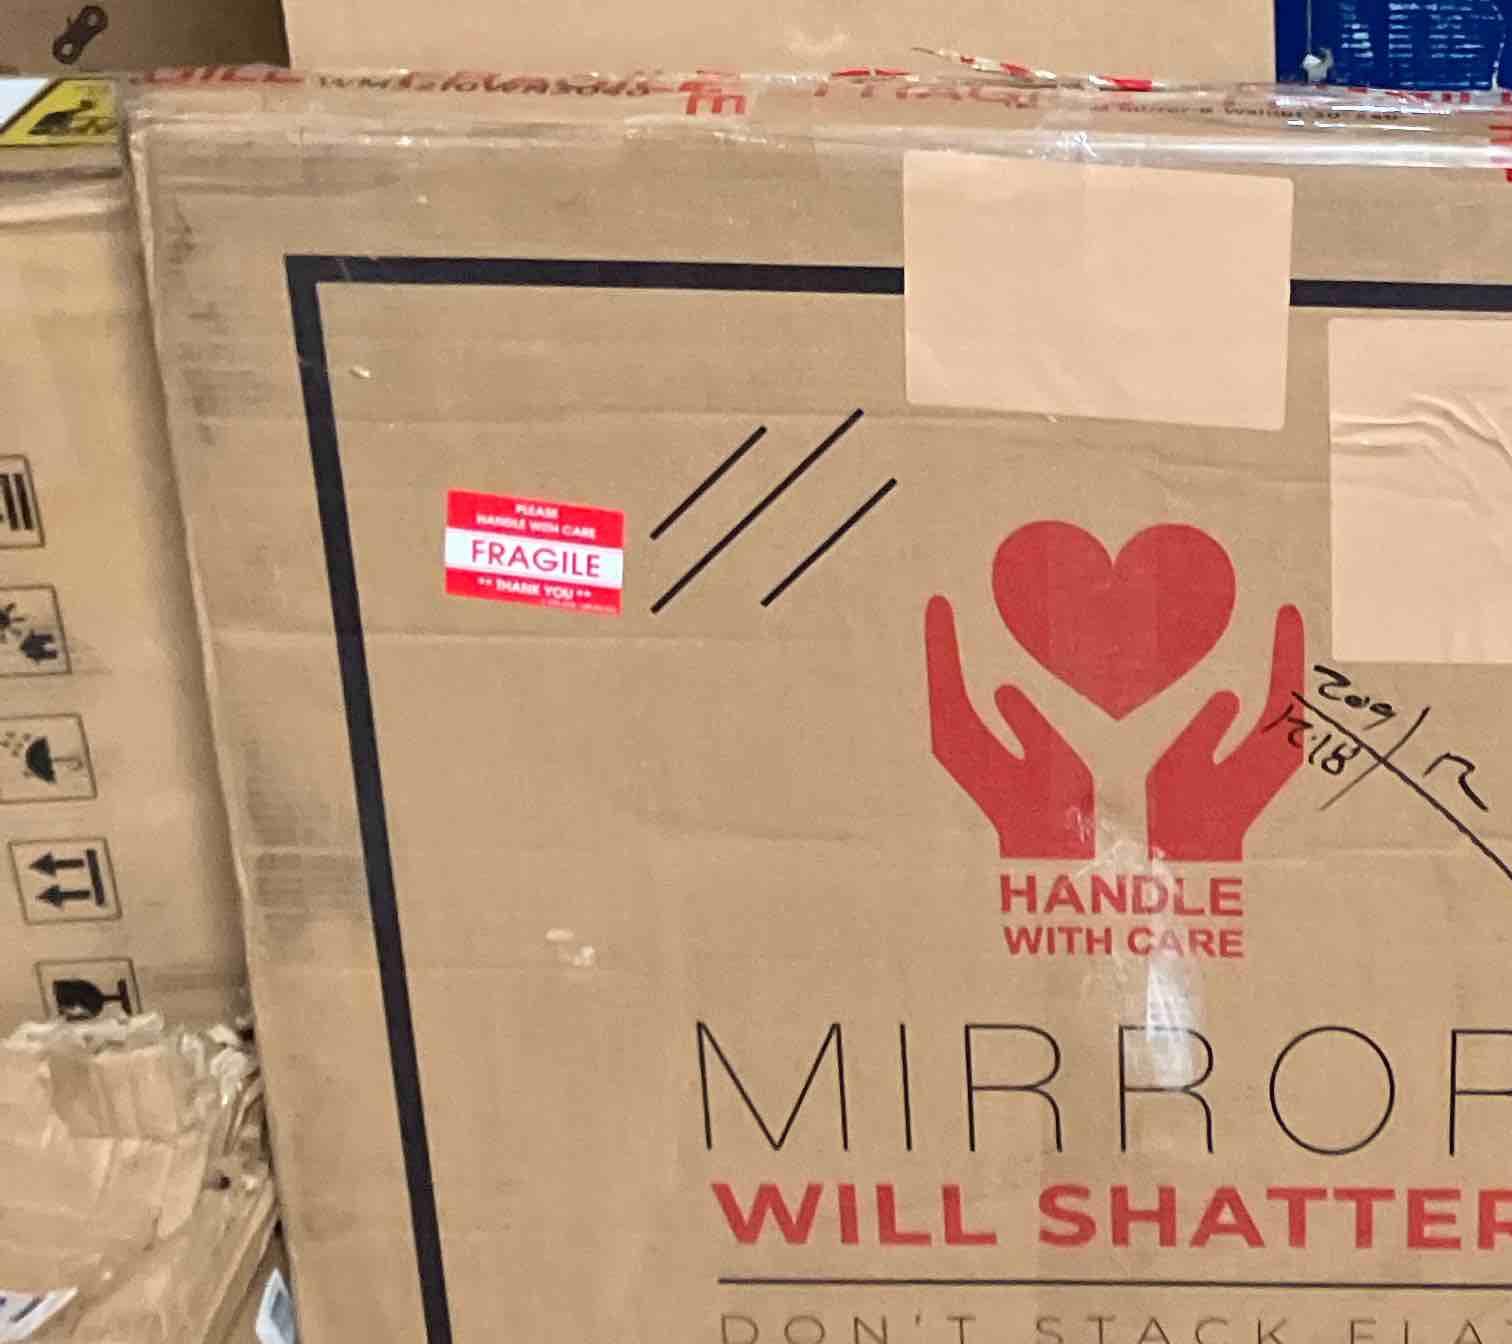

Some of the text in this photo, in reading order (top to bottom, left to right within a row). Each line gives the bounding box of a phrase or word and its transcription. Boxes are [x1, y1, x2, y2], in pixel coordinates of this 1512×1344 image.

[476, 512, 596, 540] HANDLE WITH CARE
[515, 503, 560, 519] PLEASE
[470, 539, 601, 578] FRAGILE
[542, 584, 574, 601] YOU
[1000, 874, 1244, 916] HANDLE
[1004, 926, 1244, 958] WITH CARE
[711, 1183, 997, 1248] WILL
